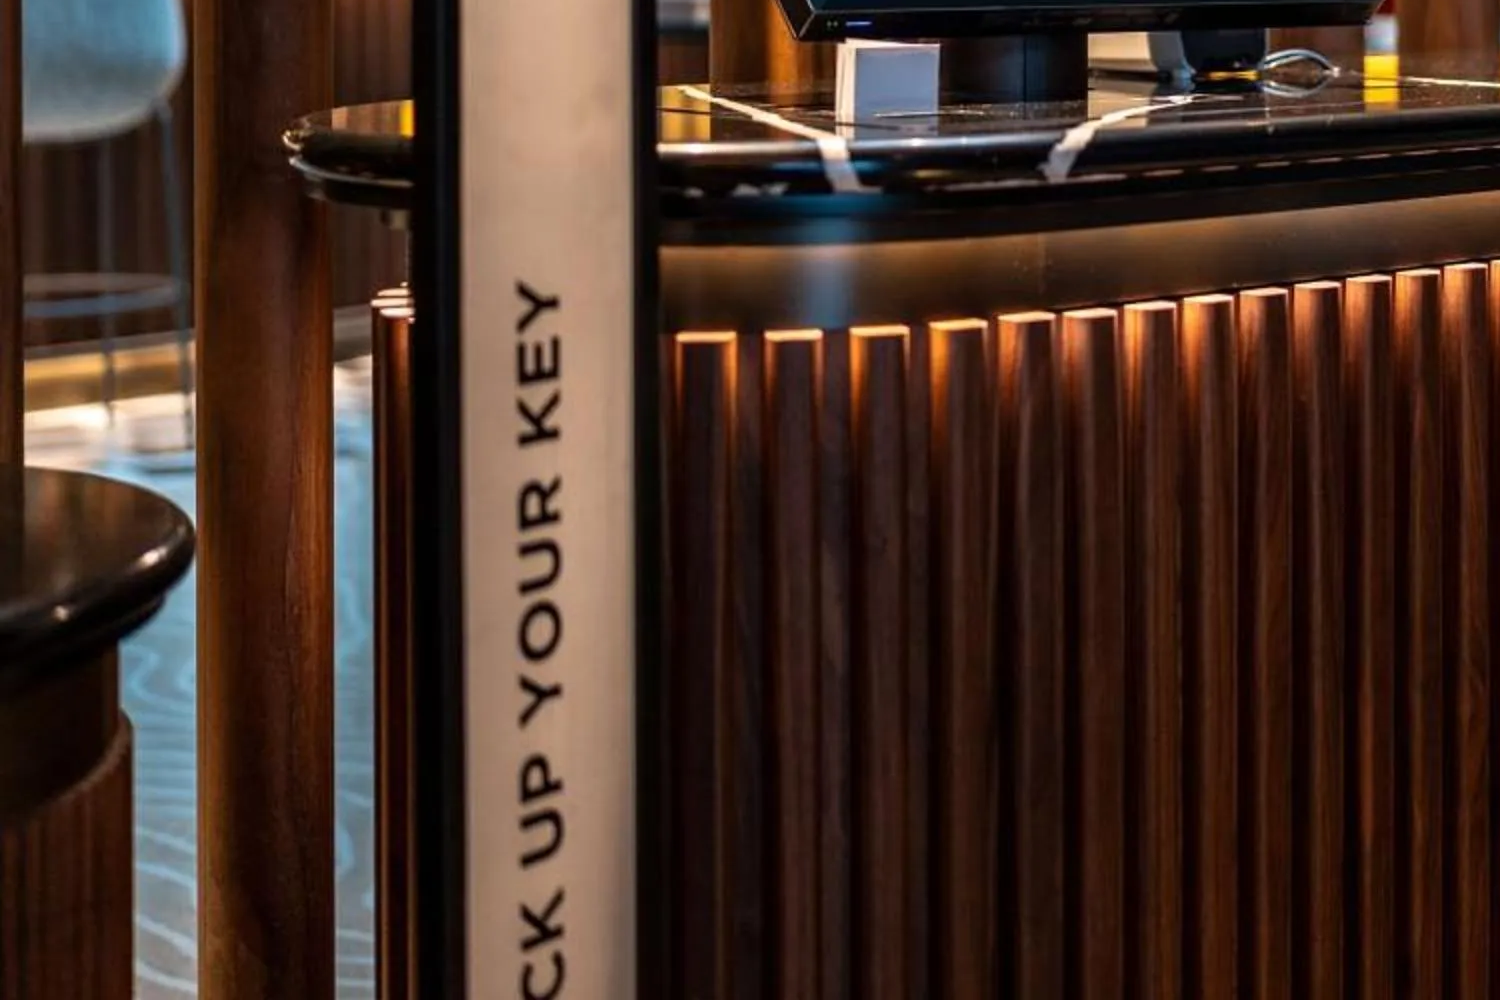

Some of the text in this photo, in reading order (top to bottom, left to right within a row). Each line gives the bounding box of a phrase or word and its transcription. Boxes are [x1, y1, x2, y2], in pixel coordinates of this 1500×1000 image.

[515, 279, 561, 449] KEY
[516, 474, 563, 730] YOUR
[518, 753, 564, 869] UP
